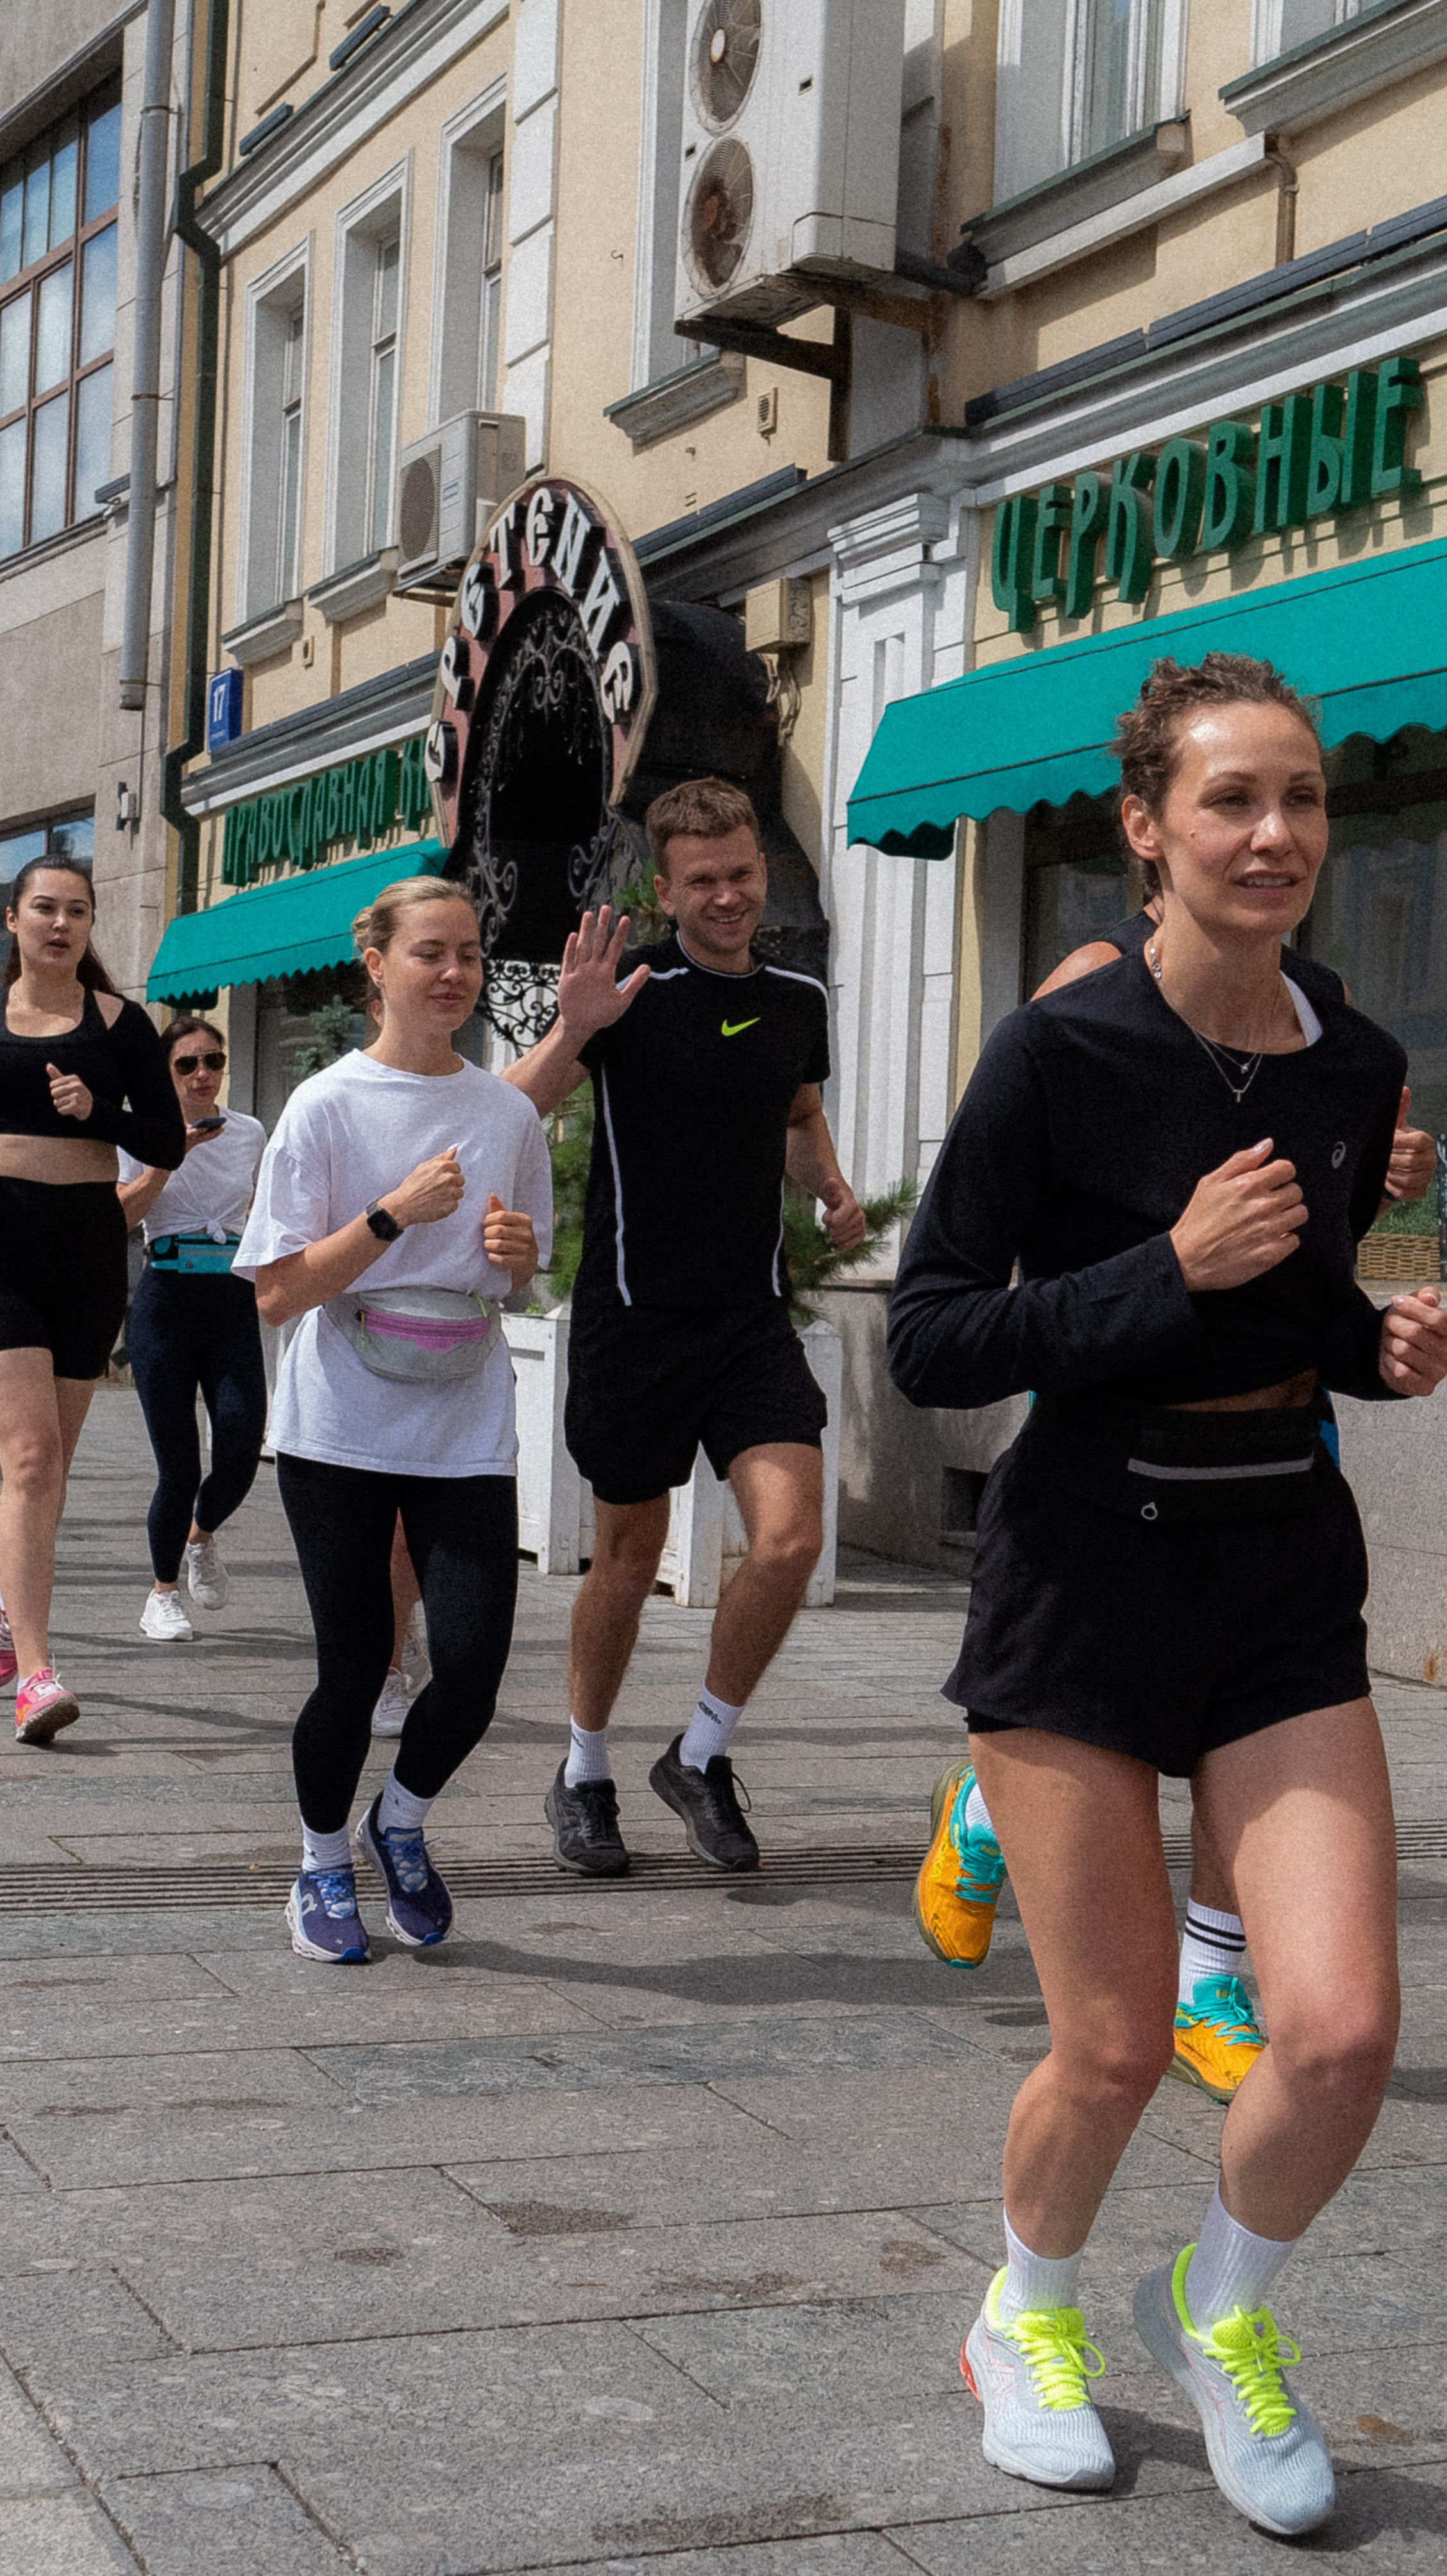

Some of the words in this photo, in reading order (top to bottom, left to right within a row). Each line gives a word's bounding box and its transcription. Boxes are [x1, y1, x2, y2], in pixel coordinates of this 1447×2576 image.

[992, 357, 1421, 633] ЦЕРКОВНЫЕ
[213, 683, 226, 723] 17
[221, 749, 399, 886] ПРАВОСЛАВНАЯ
